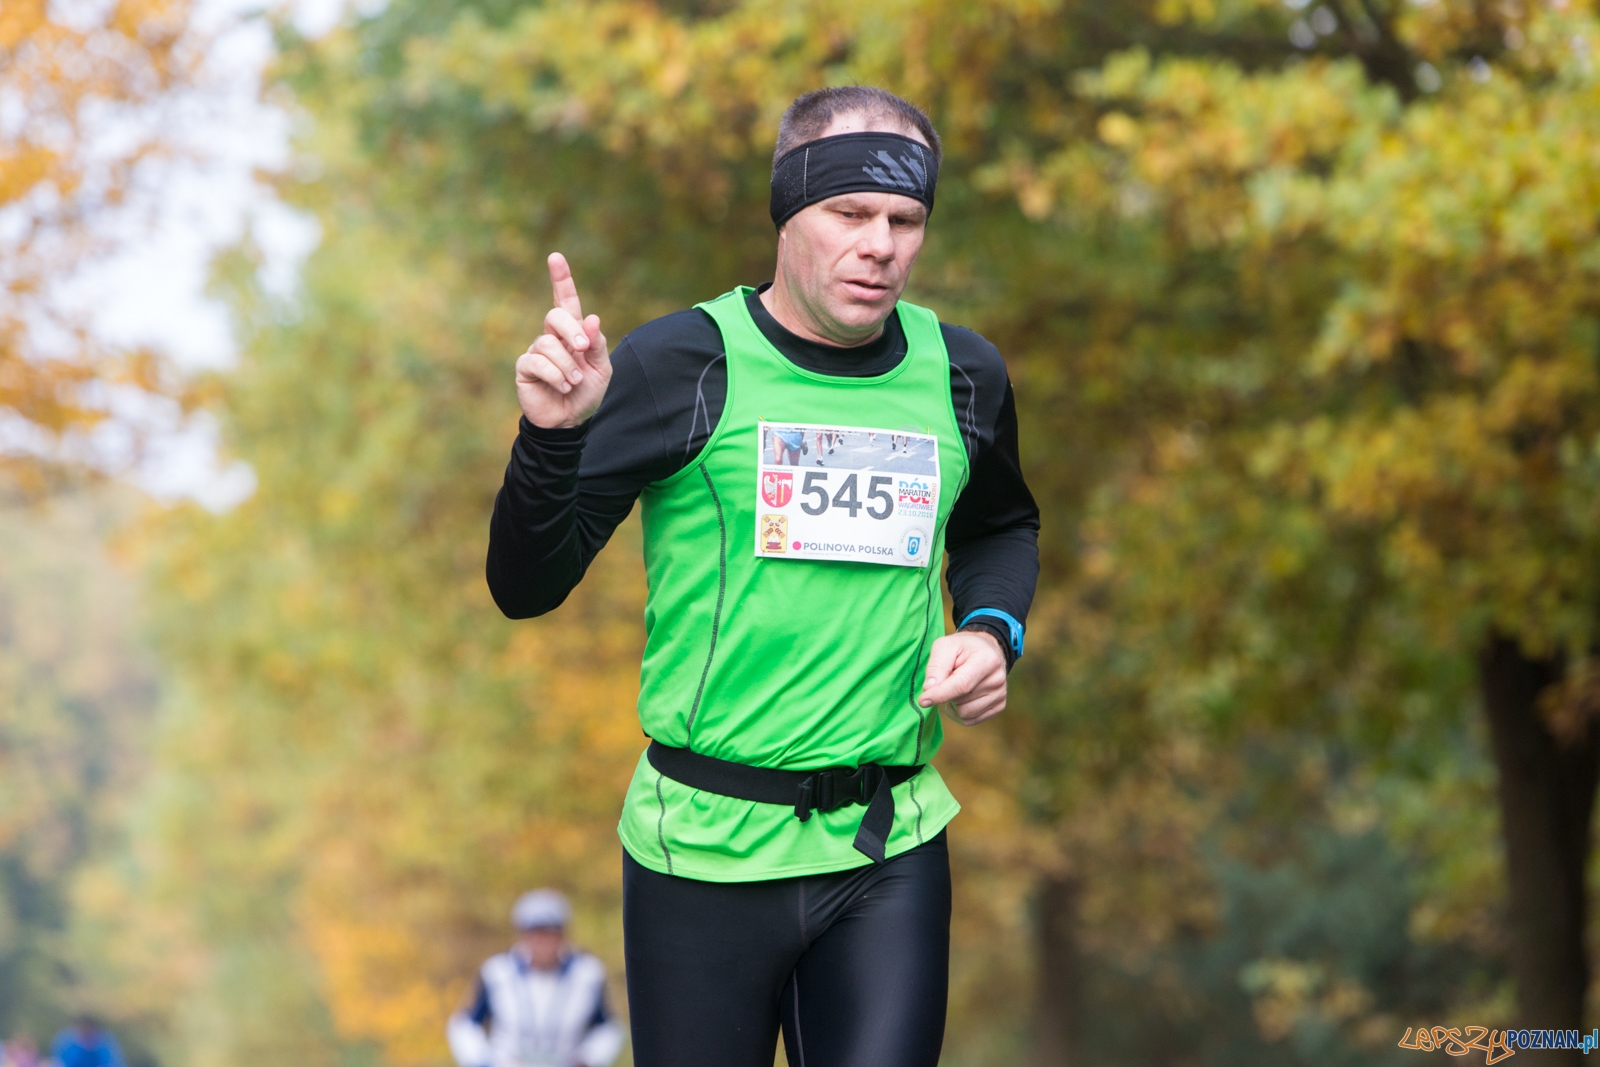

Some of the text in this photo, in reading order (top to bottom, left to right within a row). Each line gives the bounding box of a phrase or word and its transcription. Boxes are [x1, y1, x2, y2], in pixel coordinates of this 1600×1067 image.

[800, 471, 894, 520] 545
[899, 489, 931, 497] MARATON
[898, 509, 934, 518] 23.10.2016
[803, 542, 856, 553] POLINOVA
[858, 544, 894, 556] POLSKA
